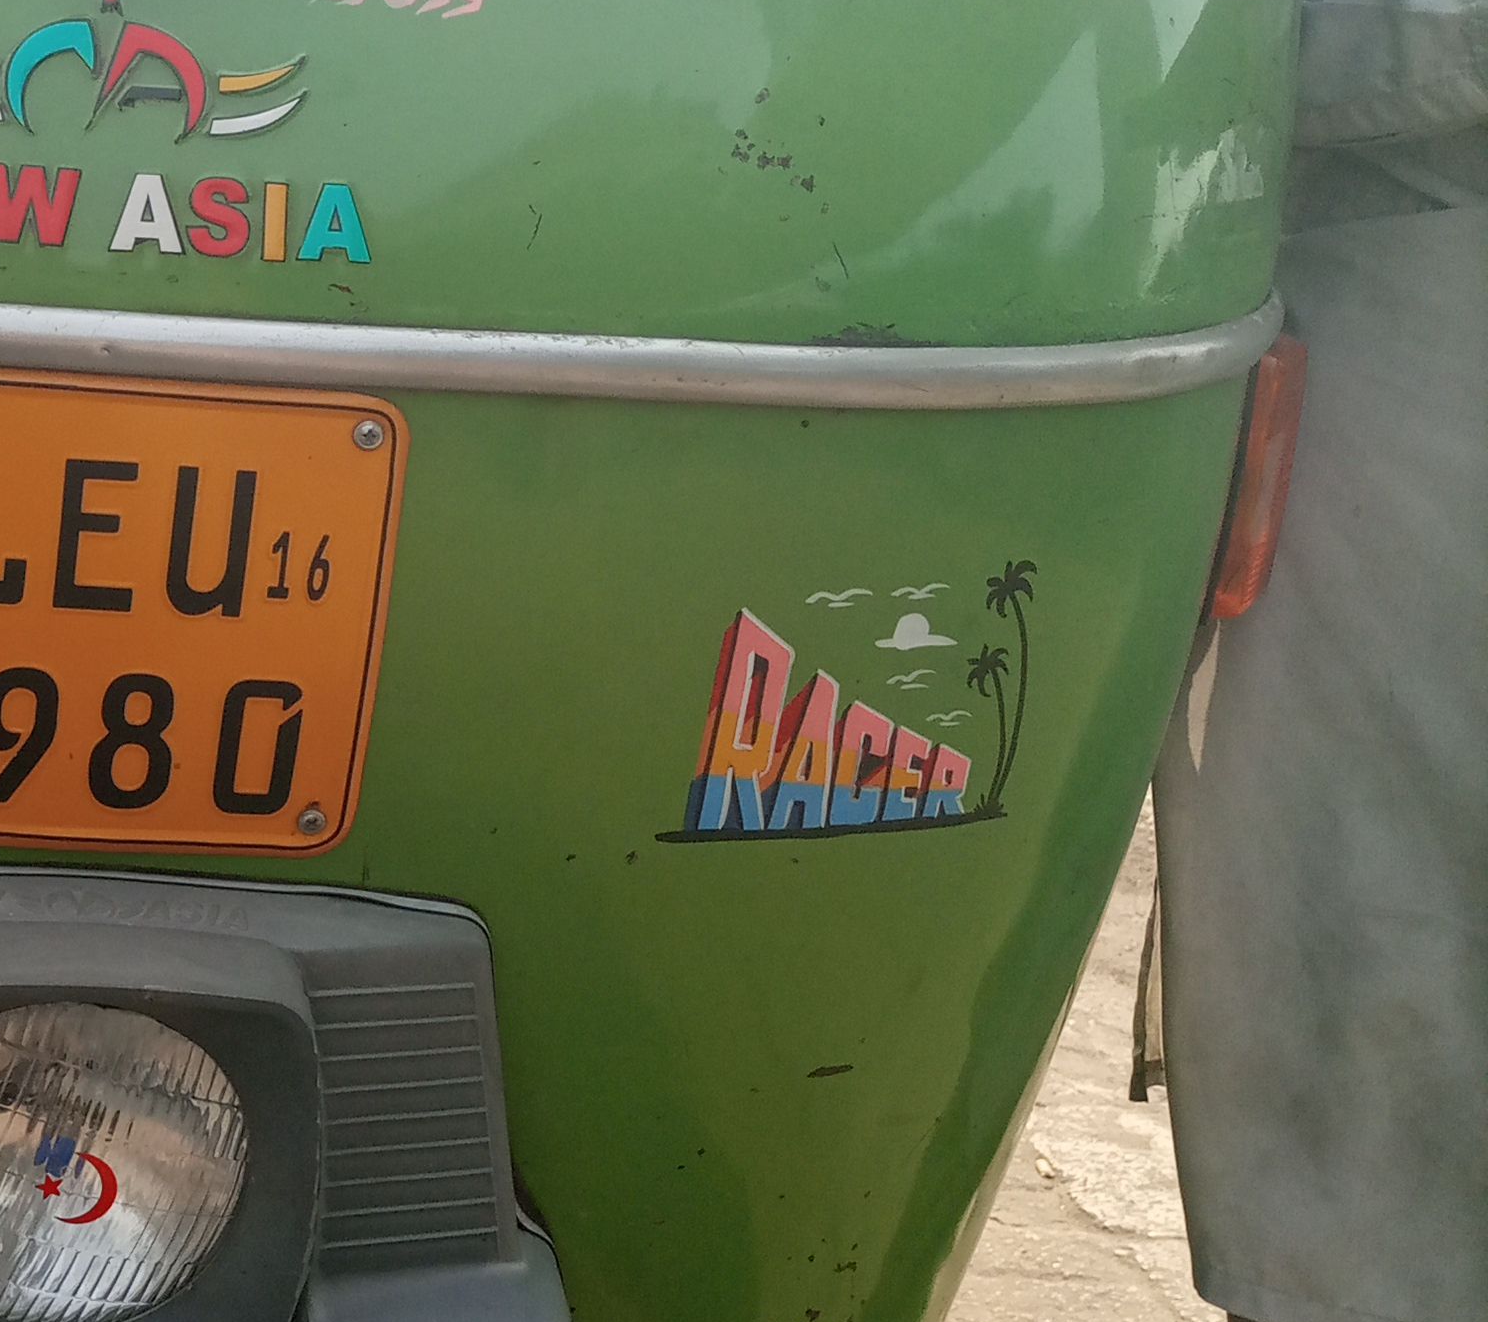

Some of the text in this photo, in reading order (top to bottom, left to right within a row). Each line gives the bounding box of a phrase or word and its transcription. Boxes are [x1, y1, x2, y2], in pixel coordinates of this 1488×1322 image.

[108, 173, 371, 264] ASIA
[266, 531, 331, 602] 16
[684, 607, 972, 831] RACER
